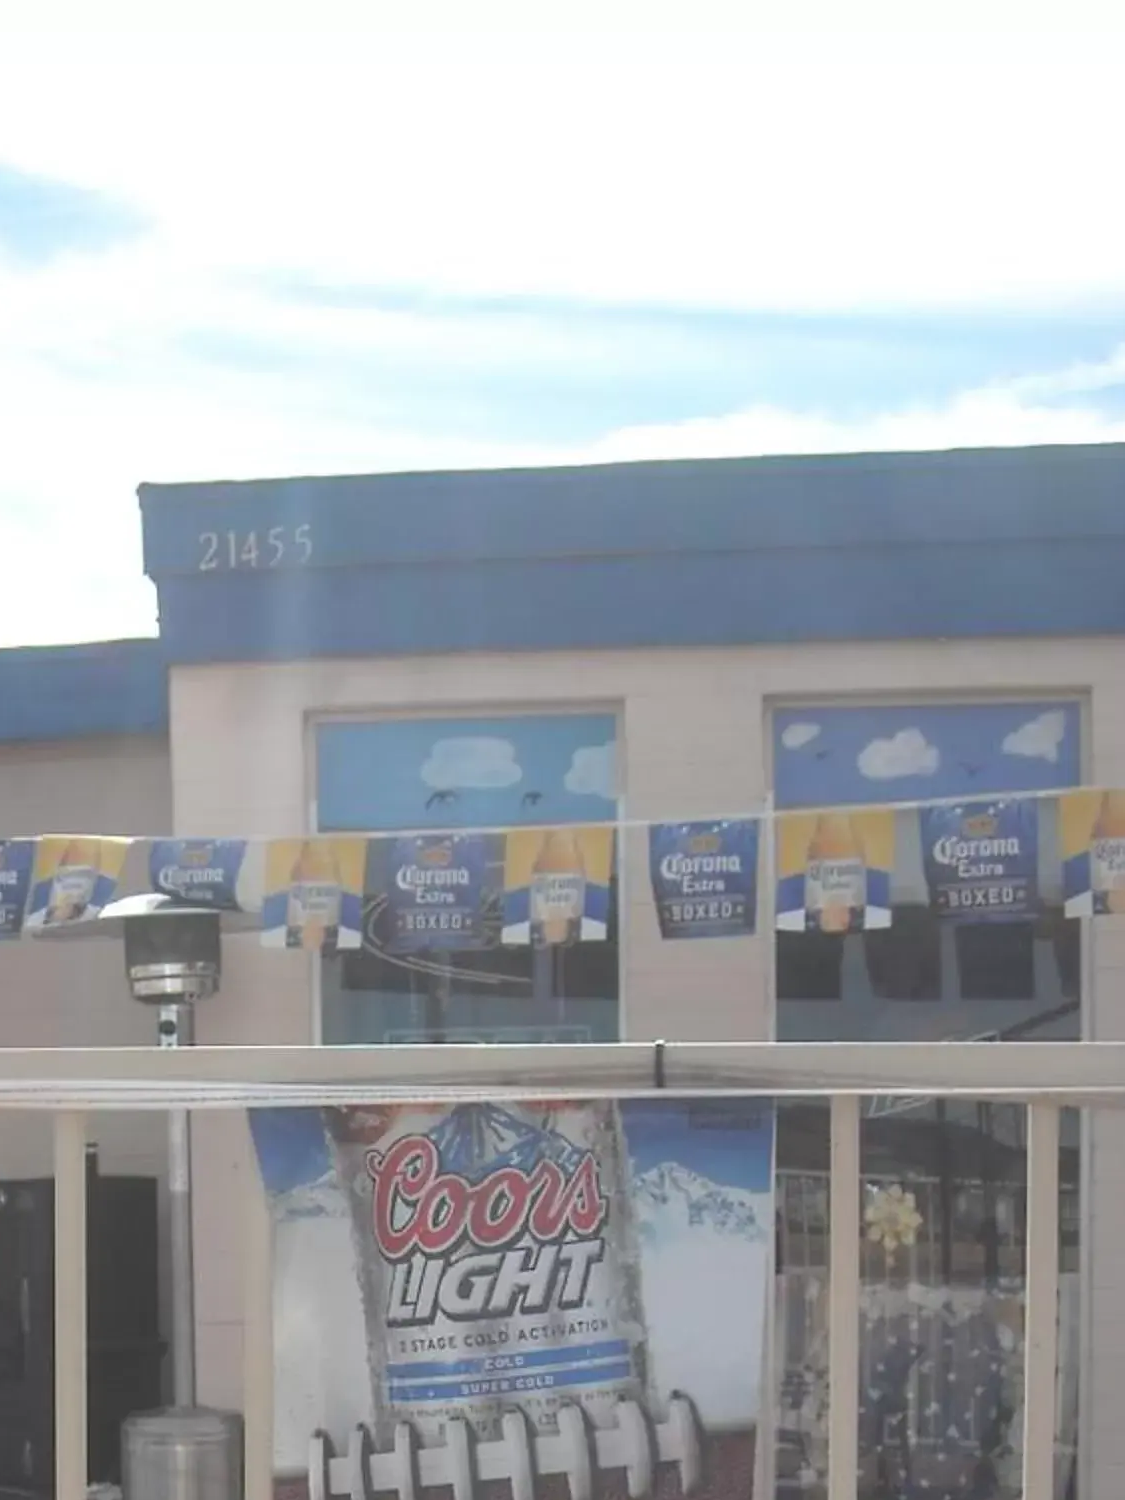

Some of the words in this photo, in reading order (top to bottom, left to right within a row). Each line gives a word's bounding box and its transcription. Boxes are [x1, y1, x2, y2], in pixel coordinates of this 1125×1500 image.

[198, 523, 313, 571] 21455
[932, 836, 1021, 866] Corona
[158, 865, 225, 892] Corona
[396, 864, 470, 891] Corona
[659, 853, 742, 880] Corona
[366, 1131, 610, 1265] Coors
[386, 1236, 607, 1328] LIGHT
[410, 1335, 458, 1354] STAGE
[463, 1330, 511, 1349] COLD
[517, 1318, 610, 1342] ACTIVATION
[483, 1355, 525, 1370] COLD
[460, 1378, 511, 1396] SUPER
[515, 1375, 555, 1390] COLD
